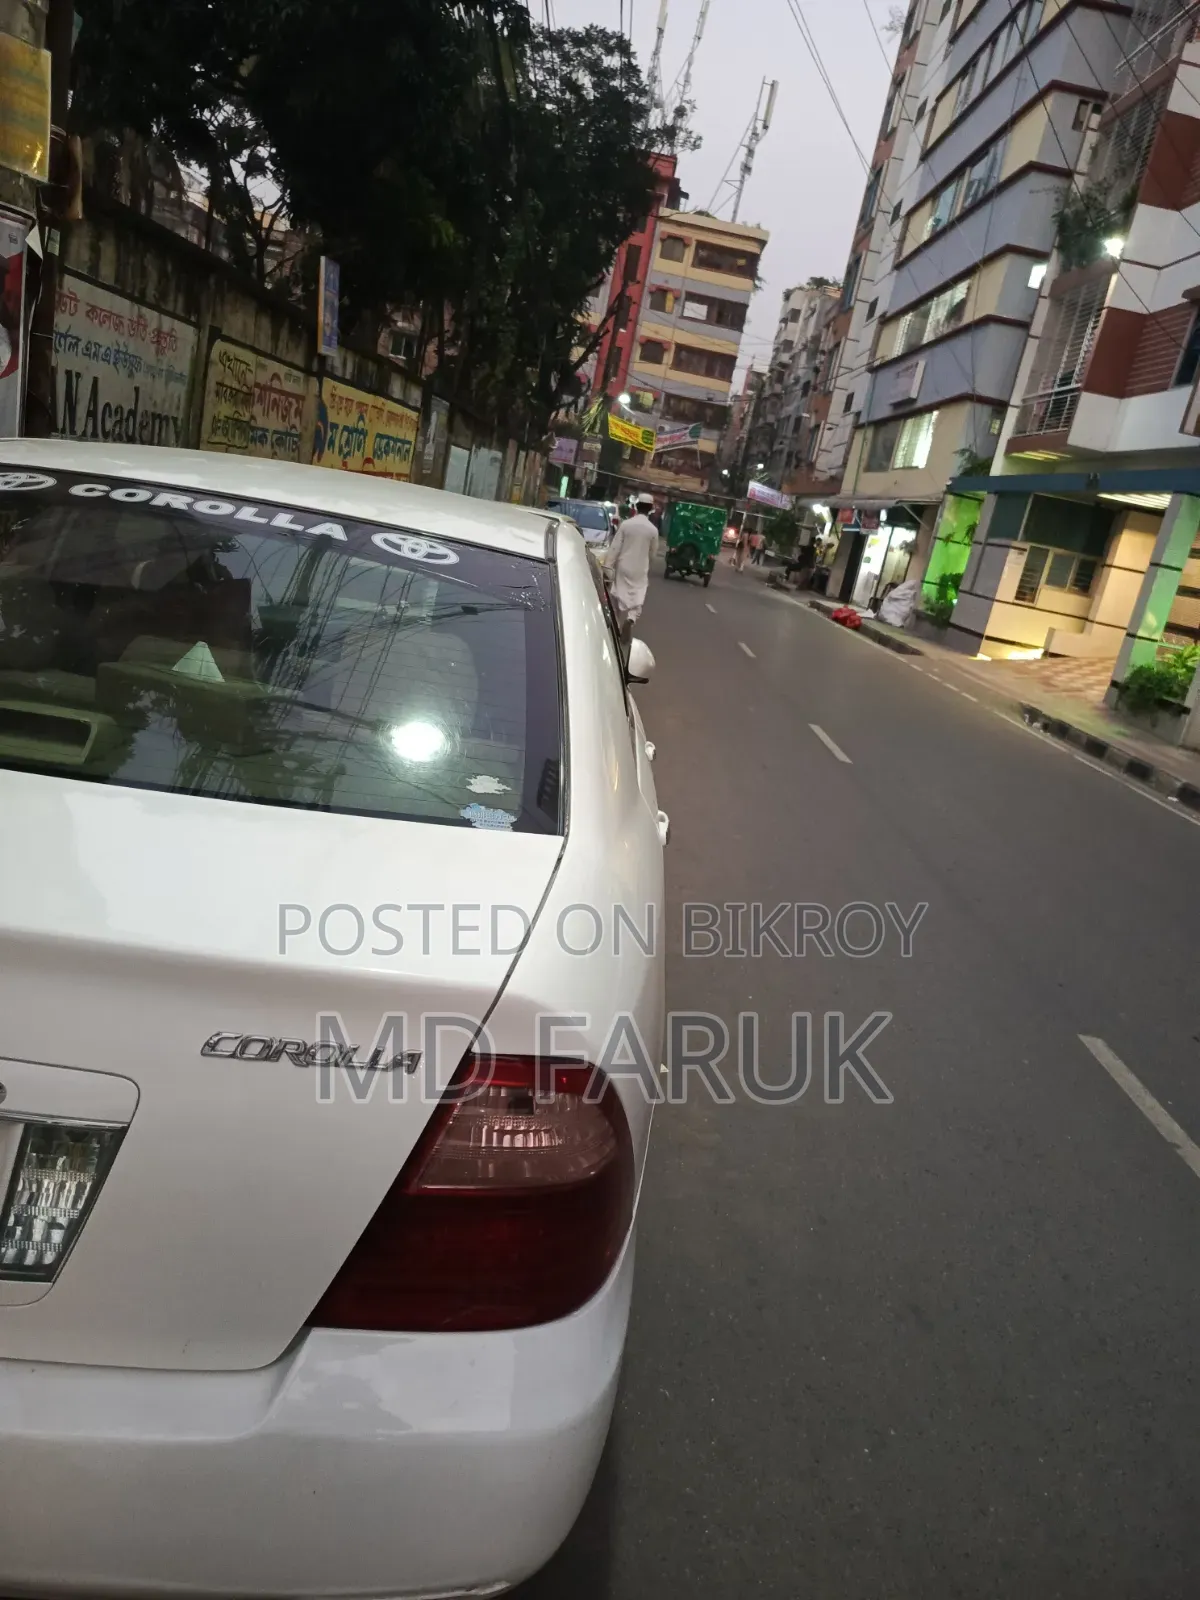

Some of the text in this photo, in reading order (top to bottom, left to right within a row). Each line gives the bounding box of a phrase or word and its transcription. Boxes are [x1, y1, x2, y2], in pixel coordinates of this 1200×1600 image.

[81, 376, 182, 446] Academy
[69, 483, 348, 541] COROLLA
[200, 1031, 423, 1075] COROLLA
